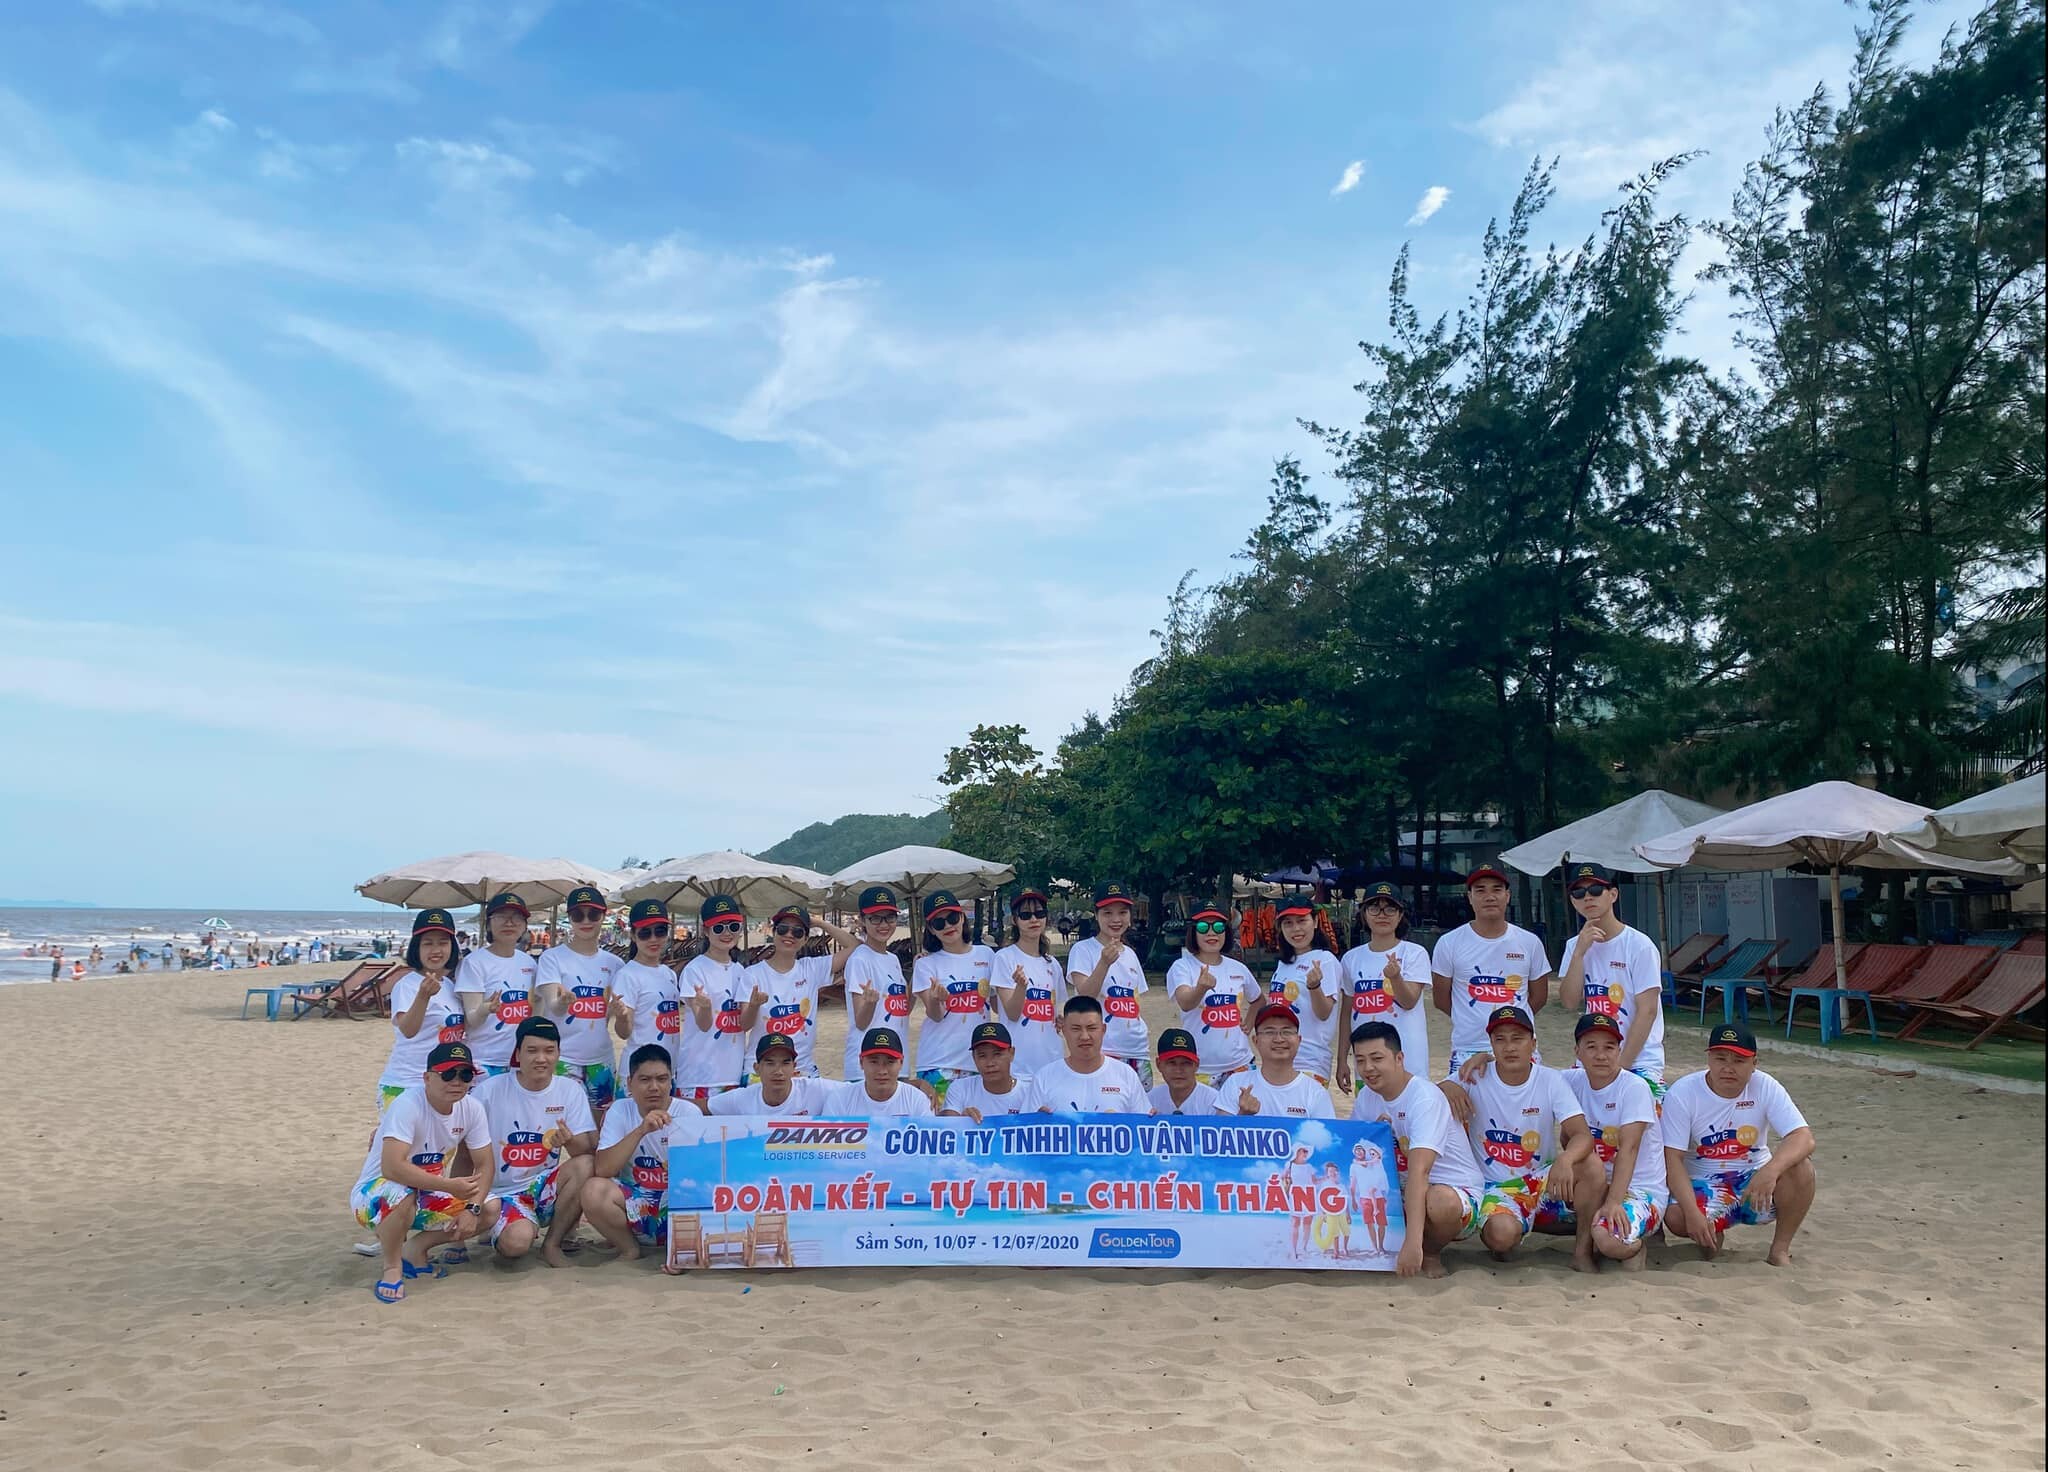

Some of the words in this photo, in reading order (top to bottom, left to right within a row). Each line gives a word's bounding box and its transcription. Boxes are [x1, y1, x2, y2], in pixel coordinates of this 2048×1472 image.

[579, 988, 597, 996] WE
[954, 983, 972, 992] WE
[1359, 982, 1377, 990] WE
[1474, 986, 1507, 998] ONE
[1588, 987, 1604, 995] WE
[509, 993, 523, 1001] WE
[1032, 989, 1045, 999] WE
[1115, 988, 1129, 997] WE
[889, 999, 909, 1011] ONE
[949, 996, 979, 1008] ONE
[1213, 996, 1230, 1005] WE
[1355, 995, 1385, 1008] ONE
[502, 1006, 529, 1018] ONE
[572, 1001, 606, 1013] ONE
[662, 1003, 676, 1011] WE
[777, 1006, 795, 1015] WE
[1027, 1003, 1052, 1016] ONE
[1110, 1000, 1136, 1014] ONE
[661, 1015, 681, 1028] ONE
[1207, 1009, 1238, 1022] ONE
[515, 1134, 536, 1143] WE
[766, 1128, 868, 1144] DANKO
[885, 1124, 956, 1155] CÔNG
[965, 1130, 993, 1154] TY
[1002, 1126, 1069, 1154] TNHH
[1079, 1126, 1131, 1154] KHO
[1138, 1121, 1193, 1160] VẬN
[1201, 1127, 1290, 1157] DANKO
[1493, 1132, 1513, 1143] WE
[1709, 1131, 1730, 1145] WE
[507, 1147, 544, 1161] ONE
[763, 1151, 815, 1161] LOGISTICS
[817, 1151, 866, 1160] SERVICES
[1488, 1145, 1523, 1162] ONE
[1703, 1145, 1739, 1156] ONE
[421, 1154, 440, 1163] WE
[643, 1159, 661, 1168] WE
[637, 1170, 668, 1184] ONE
[714, 1178, 813, 1212] ĐOÀN
[826, 1172, 890, 1210] KẾT
[903, 1194, 914, 1202] -
[930, 1179, 974, 1216] TỰ
[987, 1181, 1046, 1209] TIN
[1088, 1173, 1201, 1210] CHIẾN
[1216, 1174, 1346, 1213] THẮNG
[893, 1235, 928, 1251] Sơn,
[934, 1234, 977, 1250] 10/07
[992, 1234, 1080, 1250] 12/07/2020
